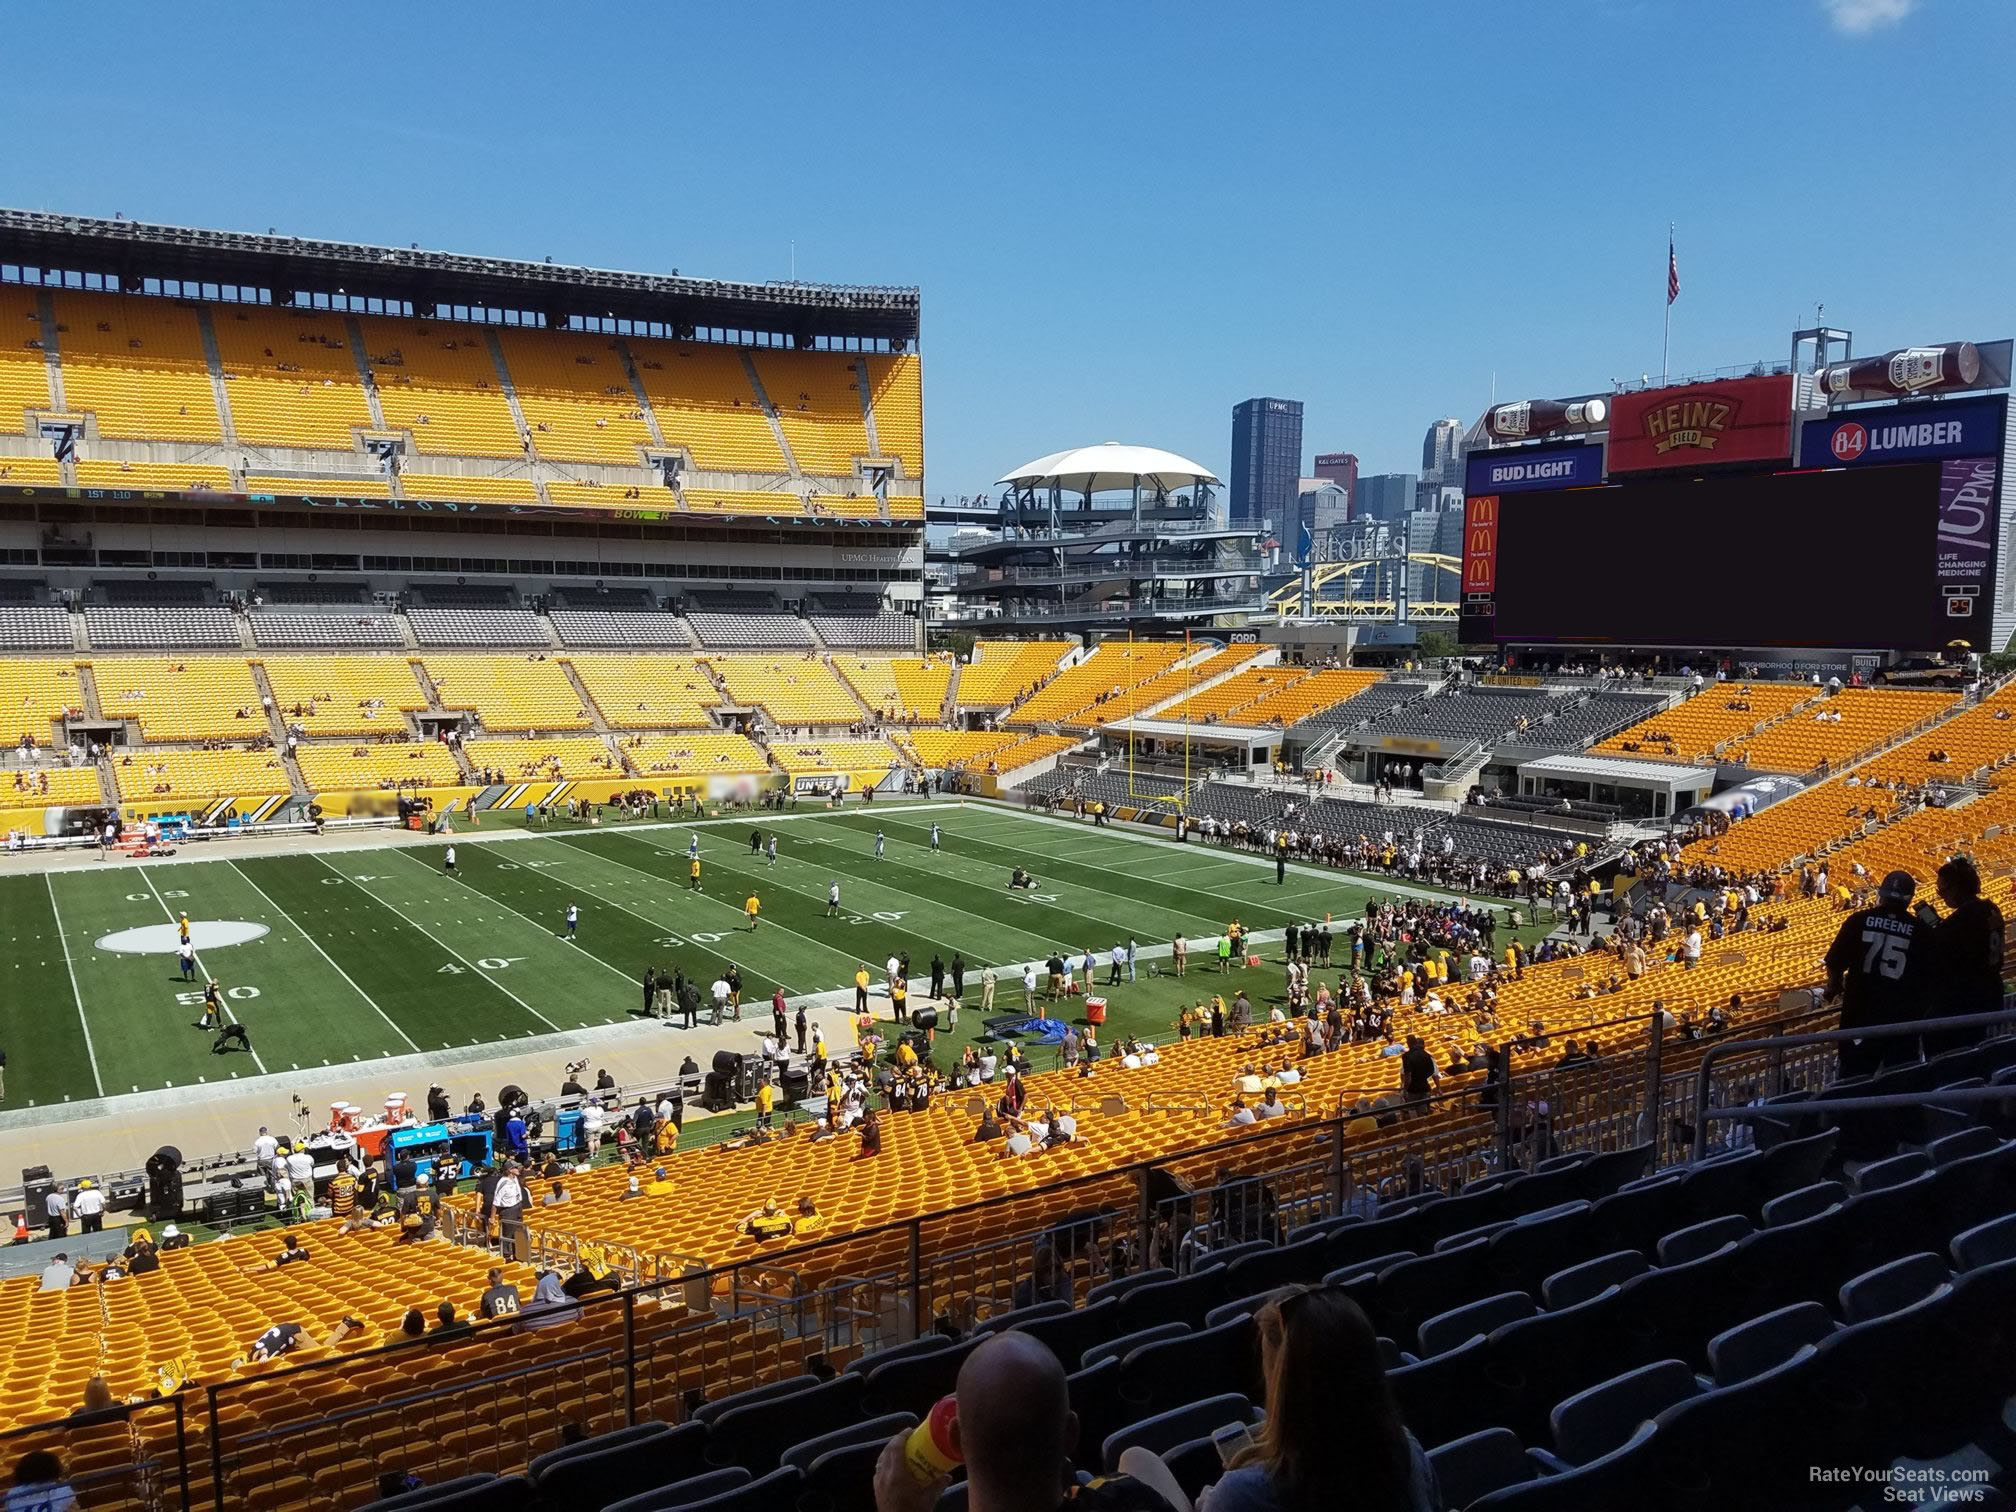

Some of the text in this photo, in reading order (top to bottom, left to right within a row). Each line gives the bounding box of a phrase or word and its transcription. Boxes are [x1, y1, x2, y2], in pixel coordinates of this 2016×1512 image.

[1269, 402, 1288, 411] UPMC
[1648, 402, 1729, 437] HEINZ
[1673, 431, 1698, 444] FIELD
[1835, 421, 1963, 454] 84 LUMBER
[1492, 461, 1573, 482] BUD LIGHT
[1938, 463, 1996, 535] UPMC
[841, 553, 868, 562] UPMC
[1938, 553, 1959, 561] LIFE
[1938, 560, 1987, 569] CHANGING
[1937, 569, 1982, 577] MEDICINE
[1951, 600, 1969, 614] 25
[1230, 633, 1257, 643] FORD
[1738, 661, 1800, 670] NEIGHBORHOOD
[1855, 658, 1877, 667] BUILT
[1866, 915, 1914, 936] GREENE
[1862, 930, 1911, 980] 75
[437, 957, 510, 974] 40
[175, 986, 261, 1005] 50
[895, 1084, 907, 1098] 84
[439, 1165, 457, 1180] 75
[495, 1294, 518, 1315] 84
